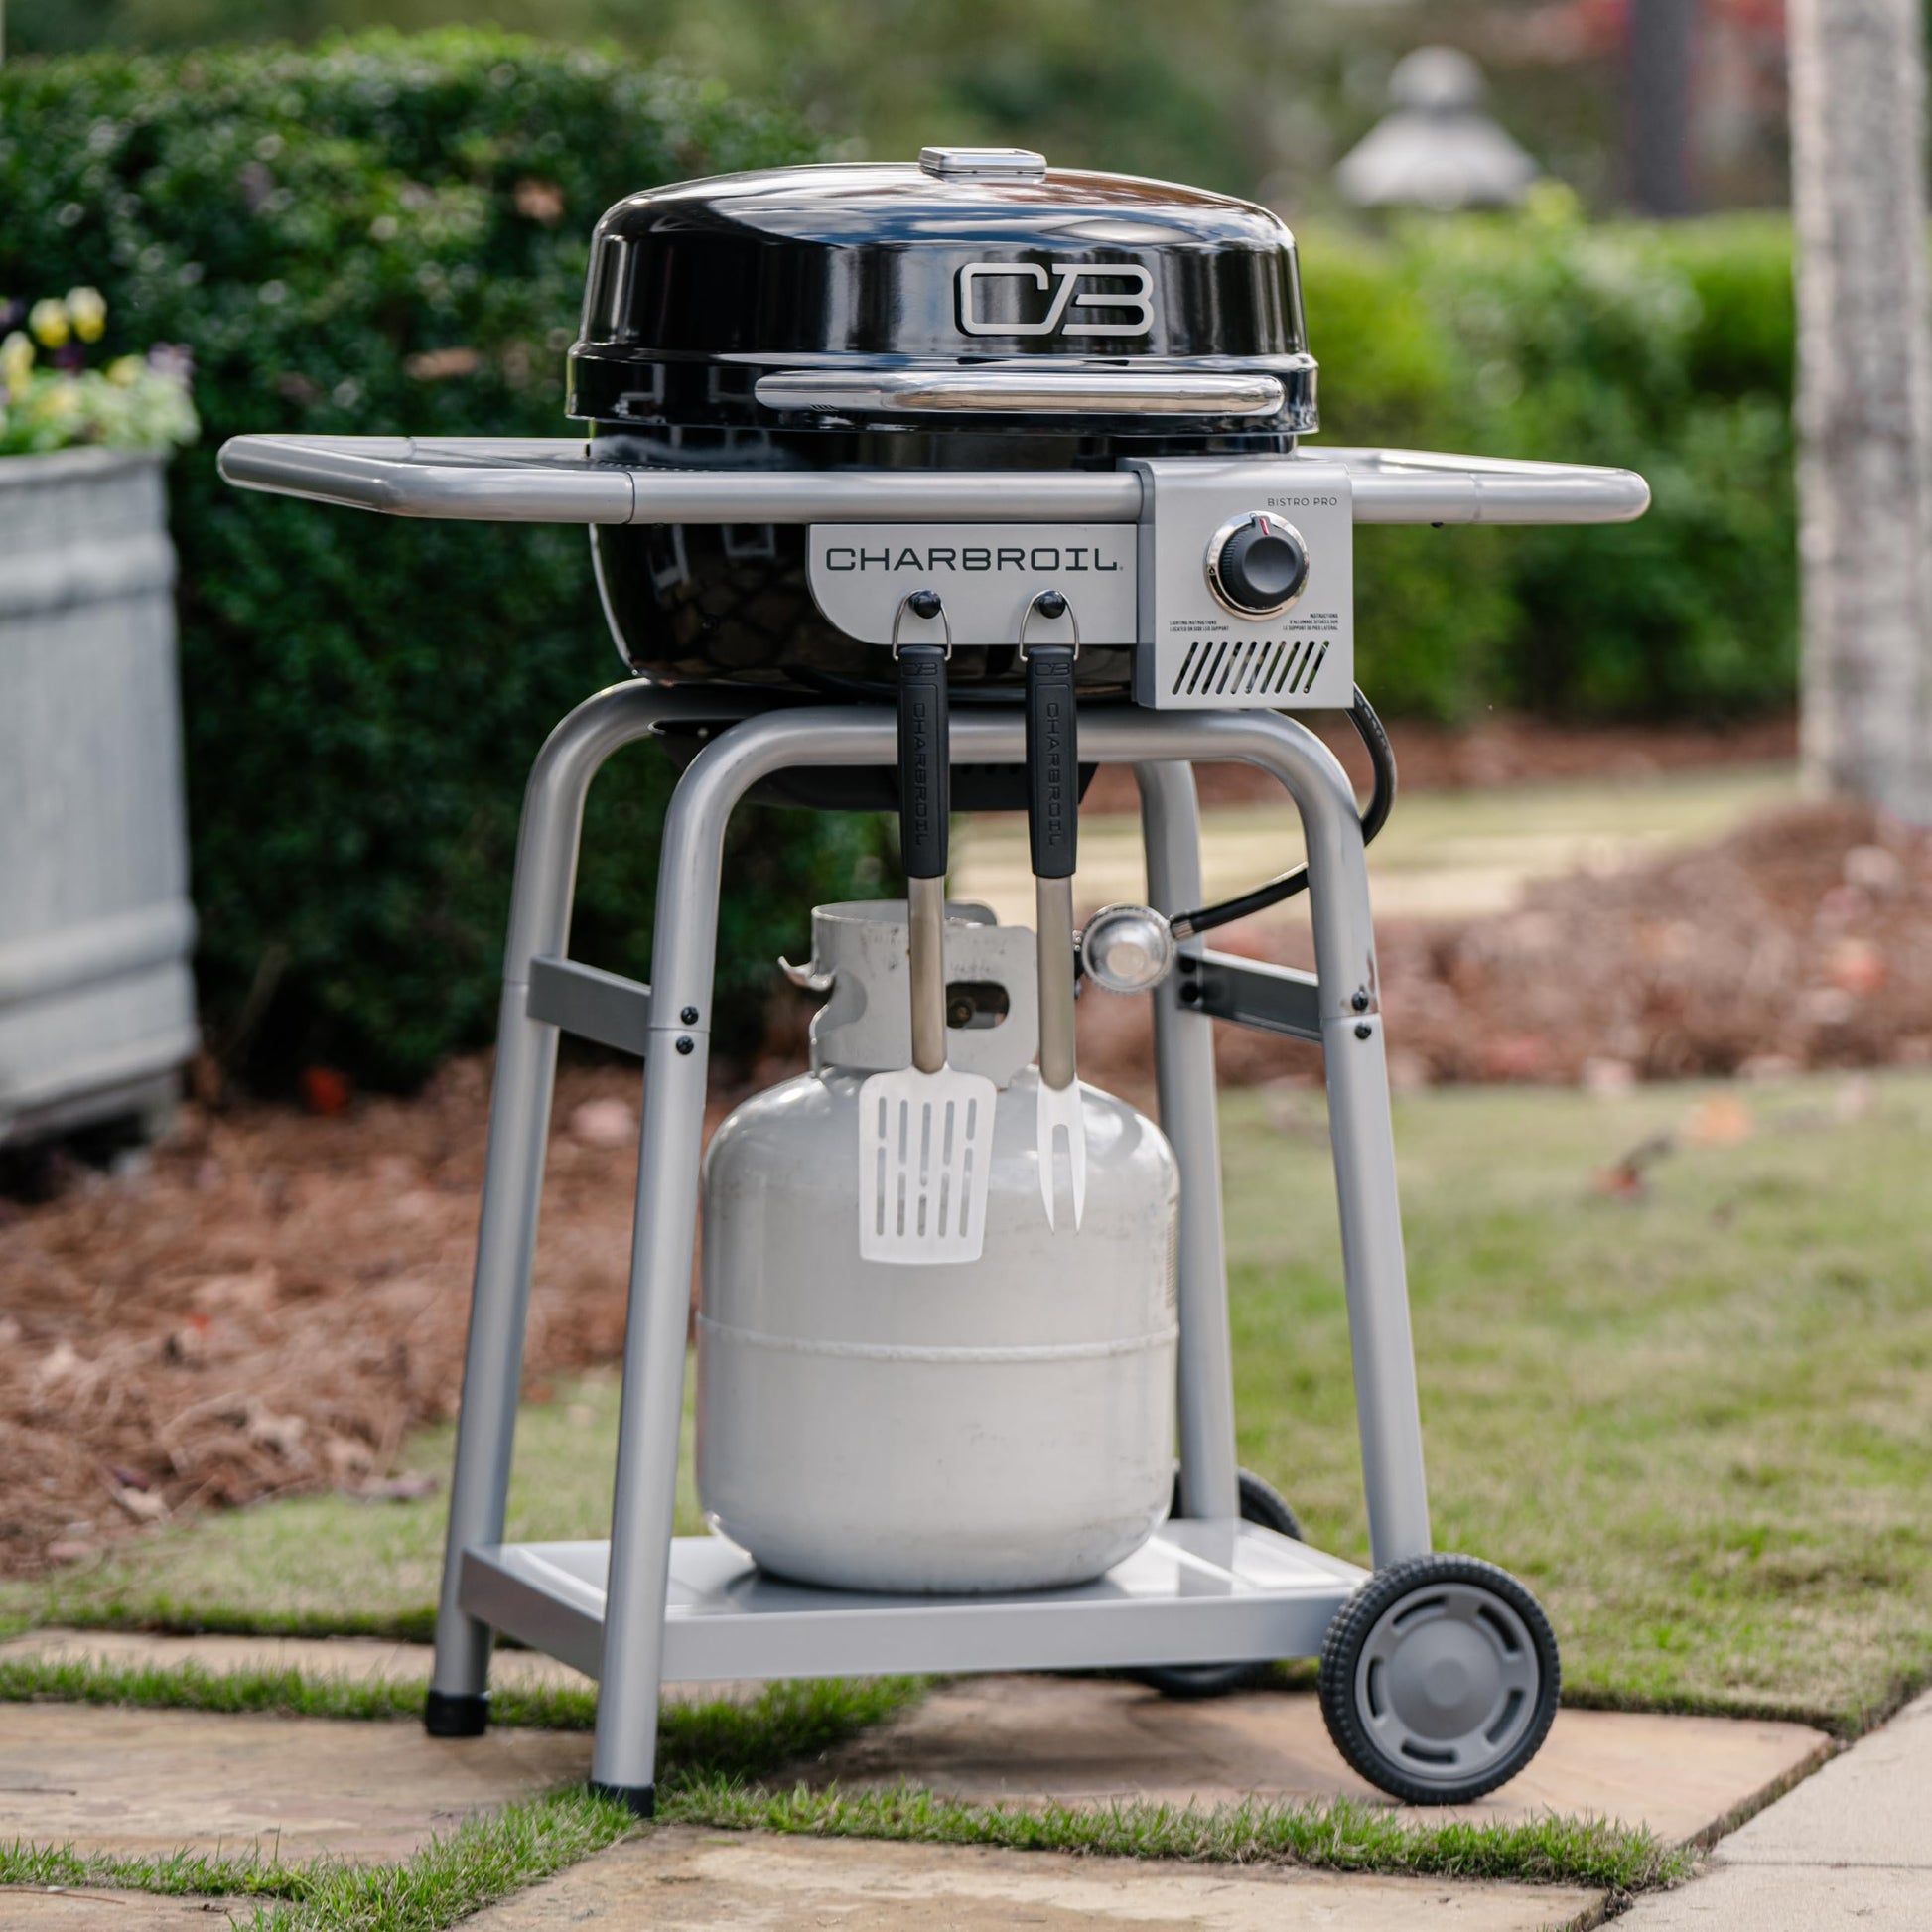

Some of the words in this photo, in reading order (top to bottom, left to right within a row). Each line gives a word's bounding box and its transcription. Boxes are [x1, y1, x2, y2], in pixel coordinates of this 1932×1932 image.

[1267, 497, 1310, 507] BISTRO
[1313, 497, 1338, 506] PRO
[826, 547, 1118, 571] CHARBROIL
[913, 702, 928, 846] CHARBROIL
[1046, 702, 1062, 847] CHARBROIL
